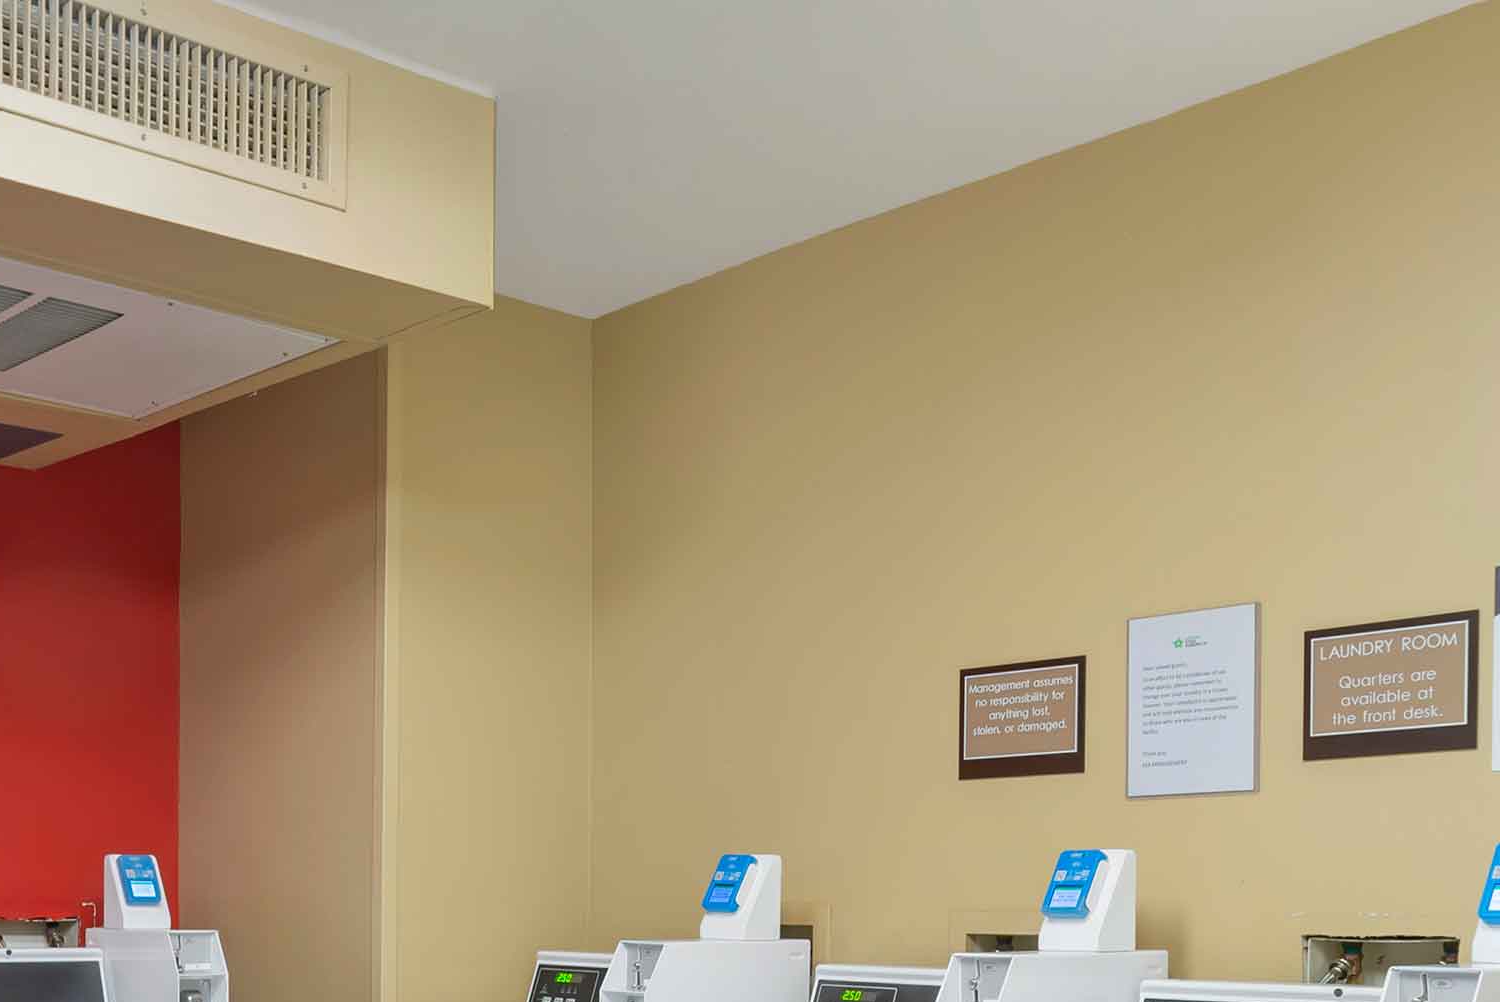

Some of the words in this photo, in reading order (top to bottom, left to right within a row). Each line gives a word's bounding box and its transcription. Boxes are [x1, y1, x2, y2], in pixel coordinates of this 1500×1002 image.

[1320, 639, 1394, 661] LAUNDRY
[1402, 632, 1459, 652] ROOM
[968, 680, 1030, 695] Management
[1033, 675, 1074, 688] assumes
[1339, 671, 1404, 689] Quarters
[1411, 670, 1437, 682] are
[975, 698, 988, 707] no
[1051, 690, 1065, 700] for
[1341, 689, 1411, 707] available
[1417, 686, 1434, 700] at
[989, 709, 1029, 721] anything
[1332, 712, 1357, 726] the
[1363, 709, 1396, 724] front
[1404, 705, 1444, 720] desk.
[1017, 720, 1068, 733] damaged.
